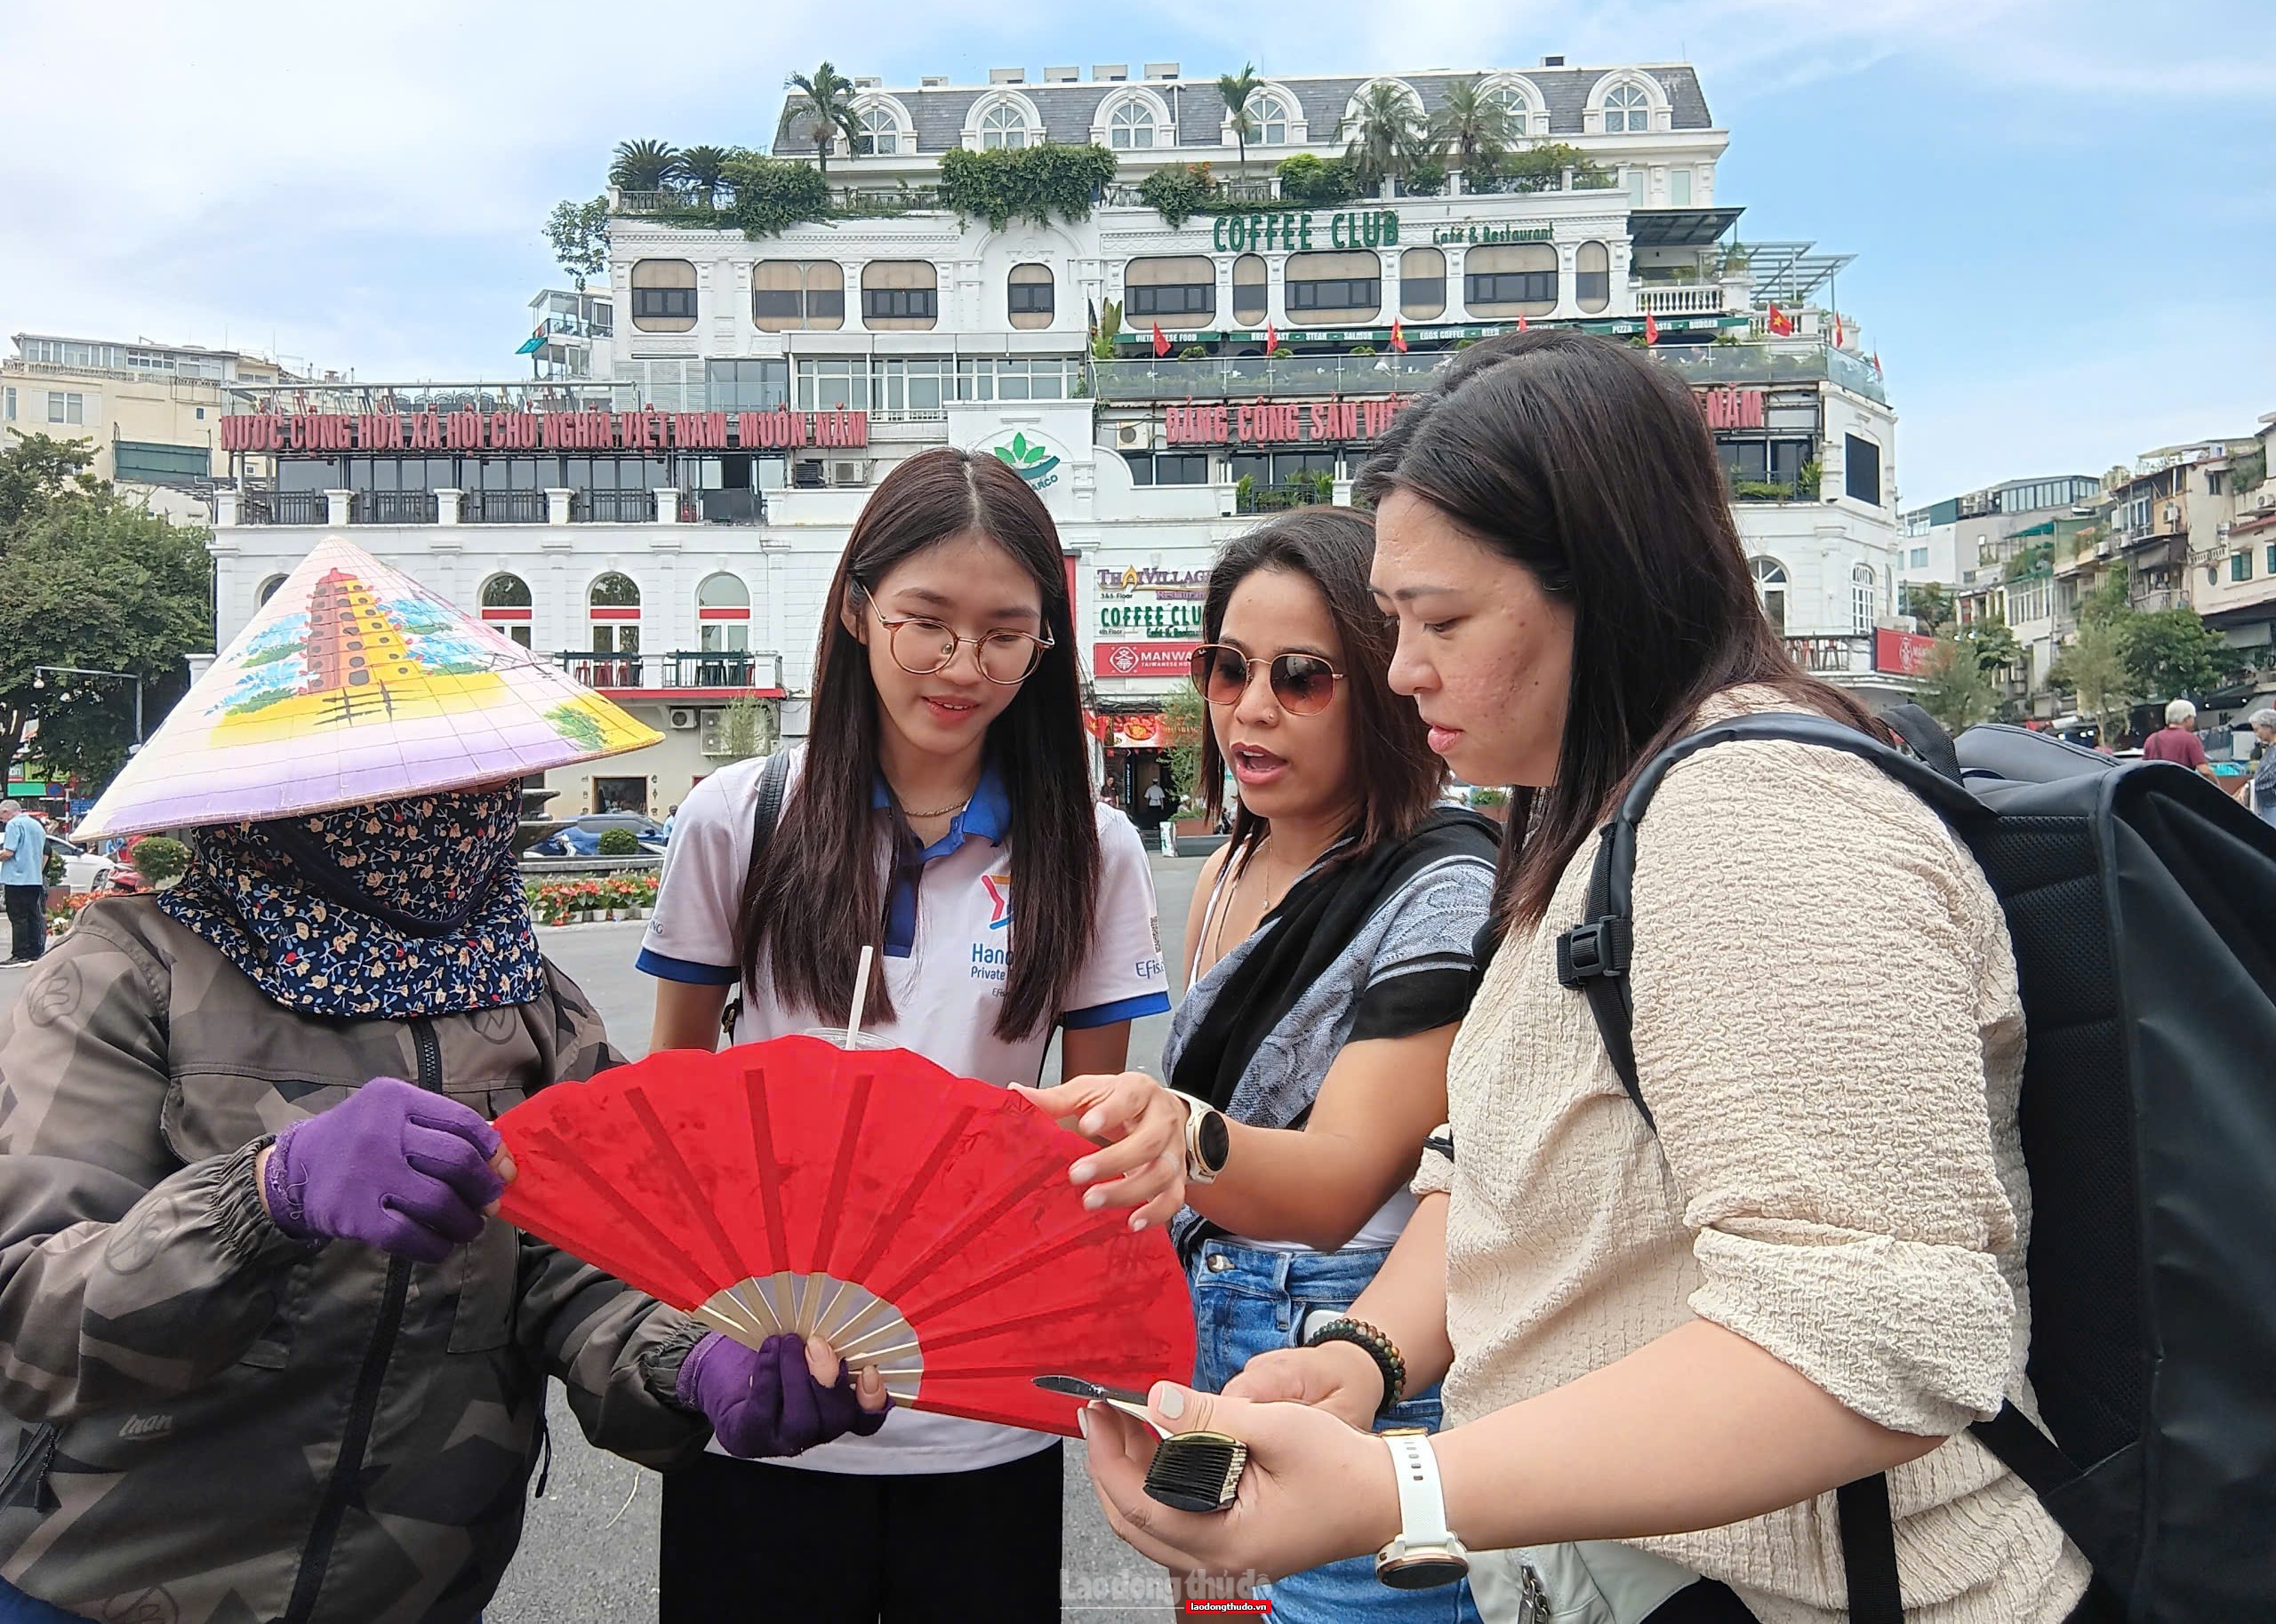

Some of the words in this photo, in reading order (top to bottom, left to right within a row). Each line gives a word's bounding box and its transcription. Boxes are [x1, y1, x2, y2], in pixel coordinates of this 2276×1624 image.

[1214, 215, 1312, 252] COFFEE
[1332, 211, 1399, 248] CLUB
[1433, 226, 1464, 244] Café
[1469, 226, 1479, 243] &
[1483, 221, 1554, 243] Restaurant
[1251, 332, 1289, 340] BREAAST
[1306, 332, 1327, 340] STEAK
[1343, 331, 1373, 340] SALMON
[1439, 329, 1465, 339] COFFEE
[1612, 324, 1633, 334] PIZZA
[1653, 323, 1672, 332] ASTA
[1135, 333, 1178, 343] VIETNESE
[1179, 333, 1198, 342] FOOD
[1166, 395, 1228, 444] ĐẢNG
[1238, 396, 1299, 449] CỘNG
[1310, 390, 1357, 439] SẢN
[1706, 382, 1761, 428] NĂM
[221, 403, 284, 451] NƯỚC
[290, 405, 351, 458] CỘNG
[358, 403, 404, 450] HÒA
[411, 404, 441, 449] XÃ
[446, 404, 484, 458] HỘI
[490, 399, 538, 449] CHỦ
[543, 404, 613, 449] NGHĨA
[621, 404, 669, 456] VIỆT
[675, 412, 726, 448] NAM
[739, 402, 807, 448] MUÔN
[815, 402, 868, 448] NĂM
[1101, 606, 1164, 627] COFFEE
[971, 965, 1006, 980] Private
